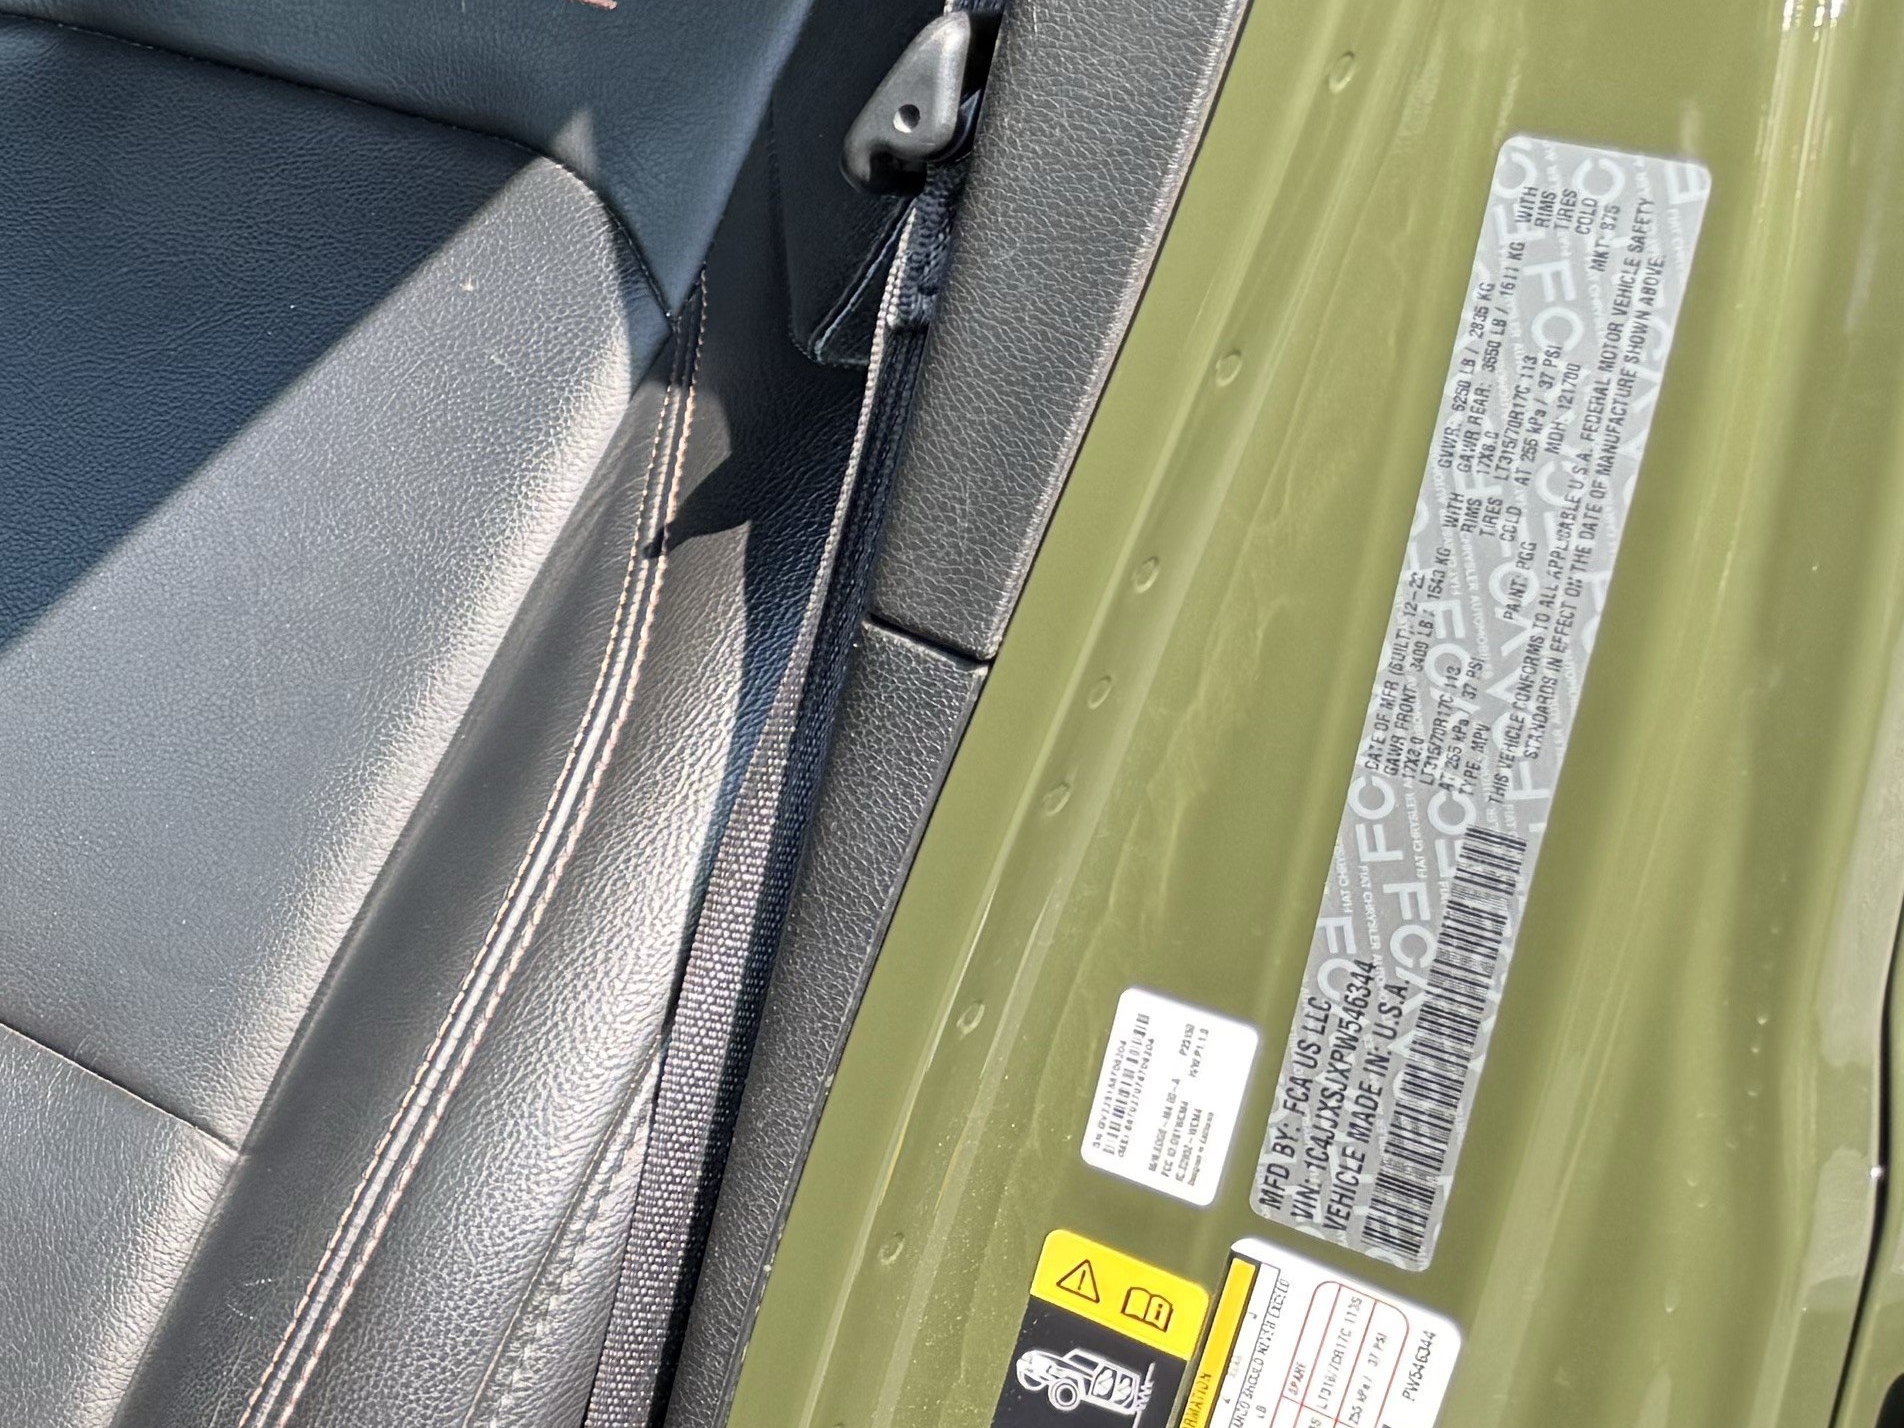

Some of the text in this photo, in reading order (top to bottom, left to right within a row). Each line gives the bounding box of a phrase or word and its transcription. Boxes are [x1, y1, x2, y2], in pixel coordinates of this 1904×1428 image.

[1456, 185, 1539, 473] GAWR REAR: 3550 LB 1611 KG WITH
[1475, 190, 1558, 476] 17X8.0 RIMS
[1493, 188, 1579, 481] LT315/70R17C 113 TIRES
[1513, 197, 1599, 485] AT 255 kPa 37 PSI COLD
[1437, 281, 1494, 468] GVWR: 6250 LB 2835 KG
[1555, 362, 1581, 410] 121700
[1544, 416, 1567, 455] MDH:
[1443, 491, 1465, 528] WITH
[1462, 496, 1482, 533] RIMS
[1480, 496, 1503, 537] TIRES
[1487, 197, 1657, 804] THIS VEHICLE CONFORMS TO ALL APPLICABLE US.A. FEDERAL MOTOR VEHICLE SAFETY
[1522, 253, 1668, 759] STANDARDS IN EFFECT ON THE DATE OF MANUFACTURE SHOWN ABOVE.
[1426, 568, 1446, 600] 1543
[1434, 545, 1452, 565] KG
[1417, 619, 1434, 637] LB
[1438, 505, 1523, 792] AT 255 kPa 37 PSI COLD
[1470, 722, 1490, 753] MPV
[1516, 539, 1537, 570] PGG
[1374, 712, 1391, 732] OF
[1379, 679, 1399, 710] MFR
[1364, 733, 1386, 771] DATE
[1384, 733, 1406, 776] GAWR
[1258, 994, 1331, 1211] MFD BY: FCA US LLC
[1291, 956, 1376, 1222] VIN: 1C4JJXSJXPW546344
[1323, 973, 1410, 1234] VEHICLE MADE IN: U.S.A.
[1401, 1328, 1436, 1402] PW546344
